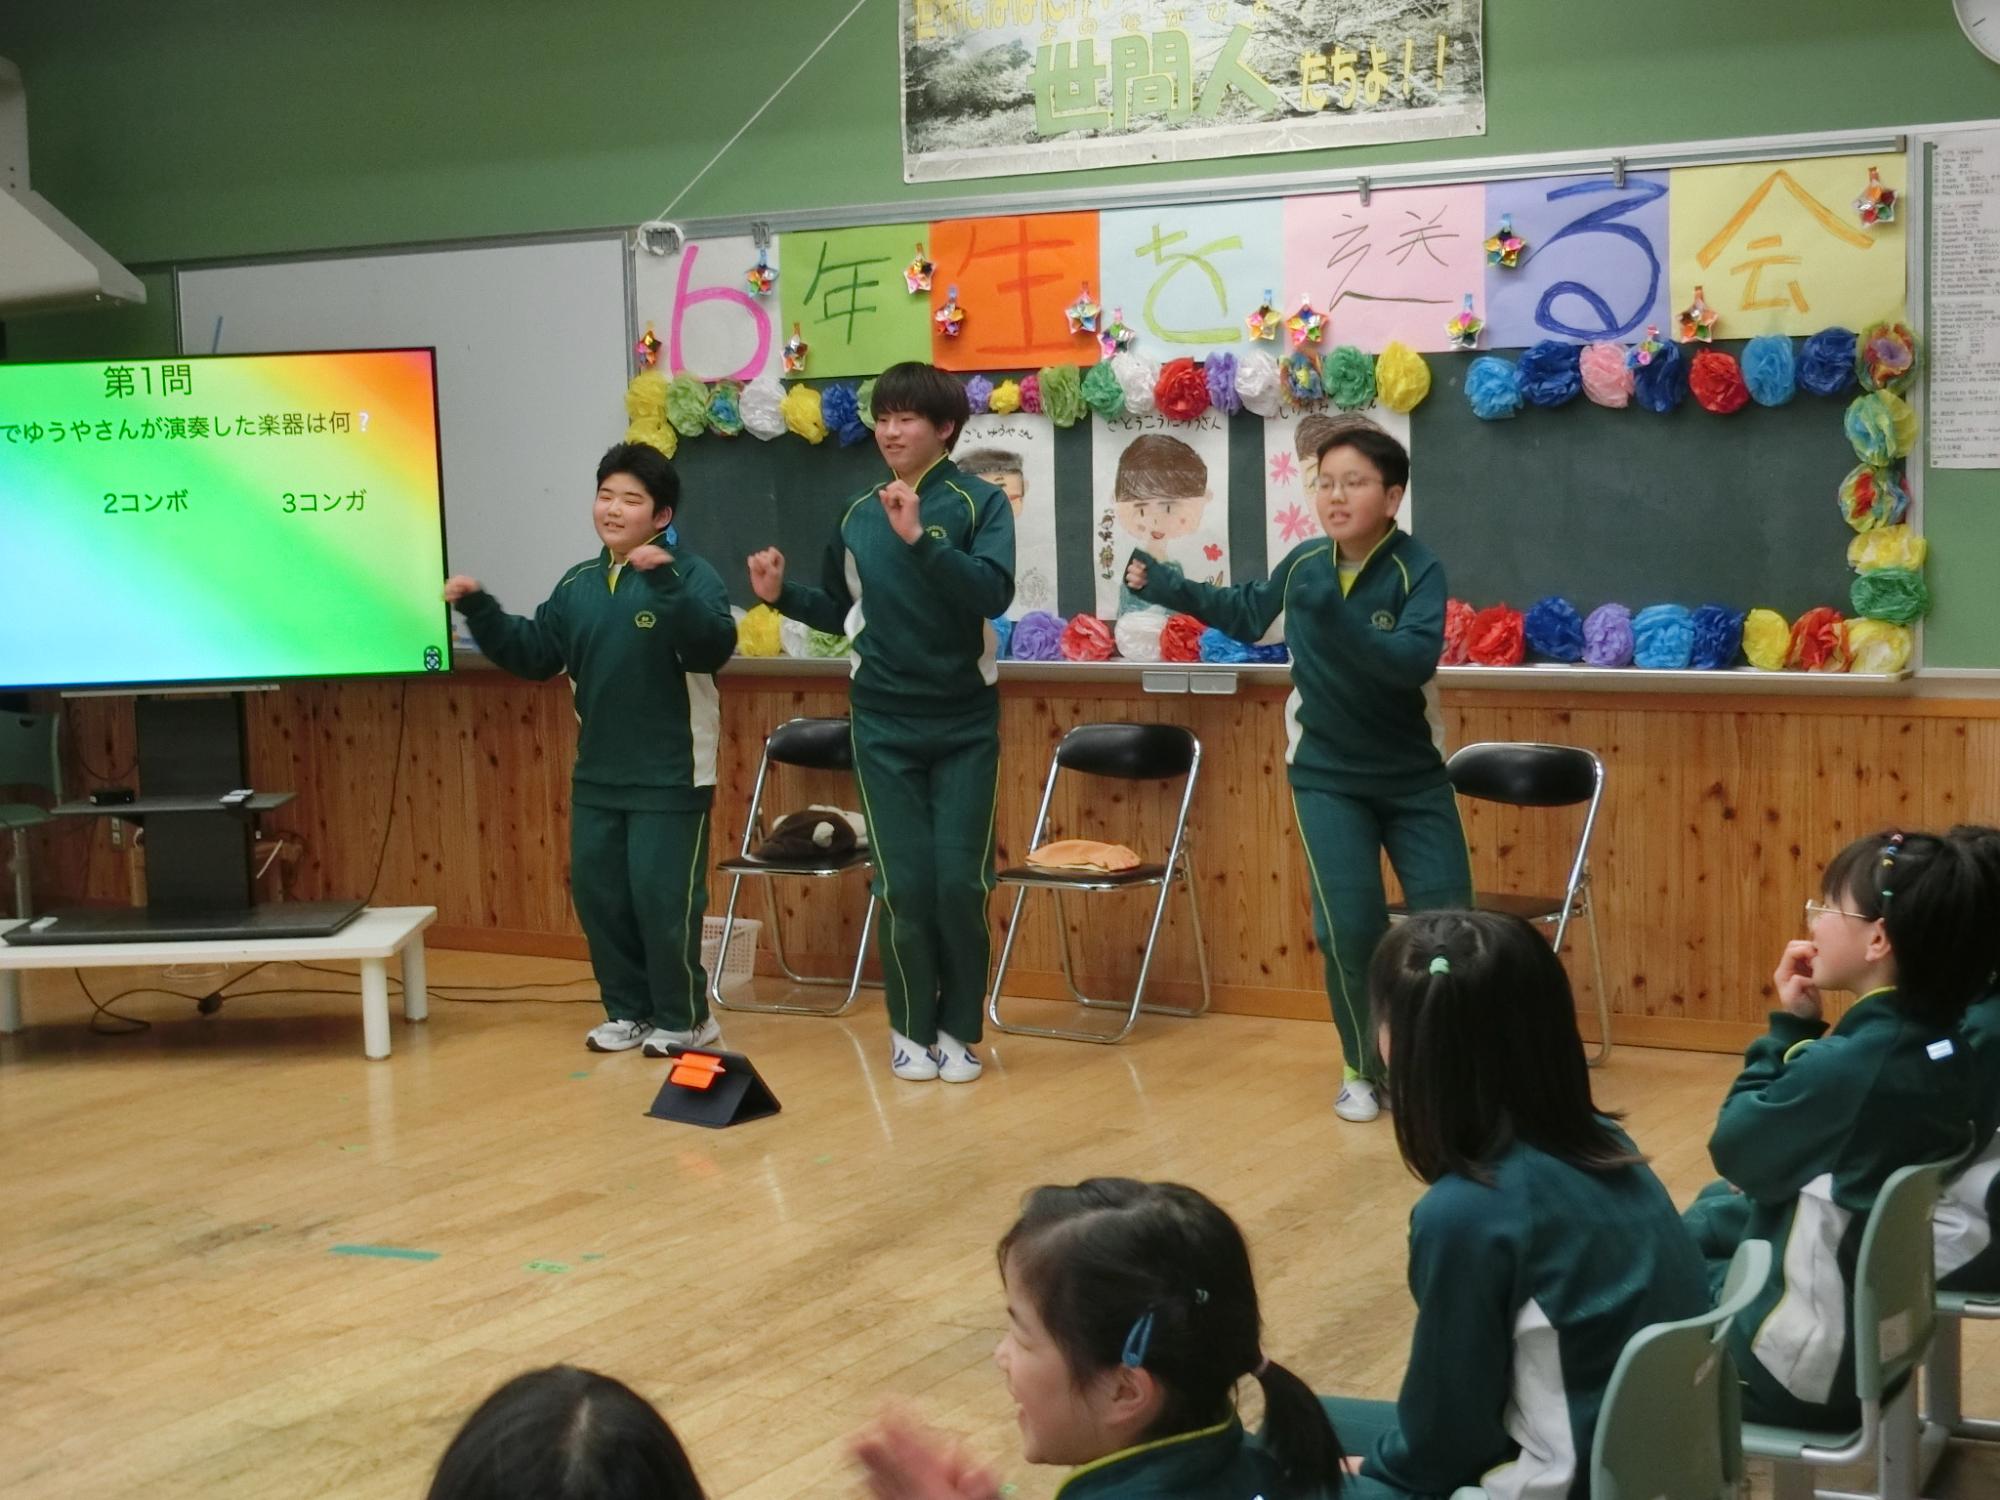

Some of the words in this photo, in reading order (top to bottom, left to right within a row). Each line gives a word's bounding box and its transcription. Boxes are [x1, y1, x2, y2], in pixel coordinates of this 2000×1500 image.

[104, 363, 193, 399] 第1問
[103, 489, 189, 515] 2コンボ
[281, 488, 367, 514] 3コンガ
